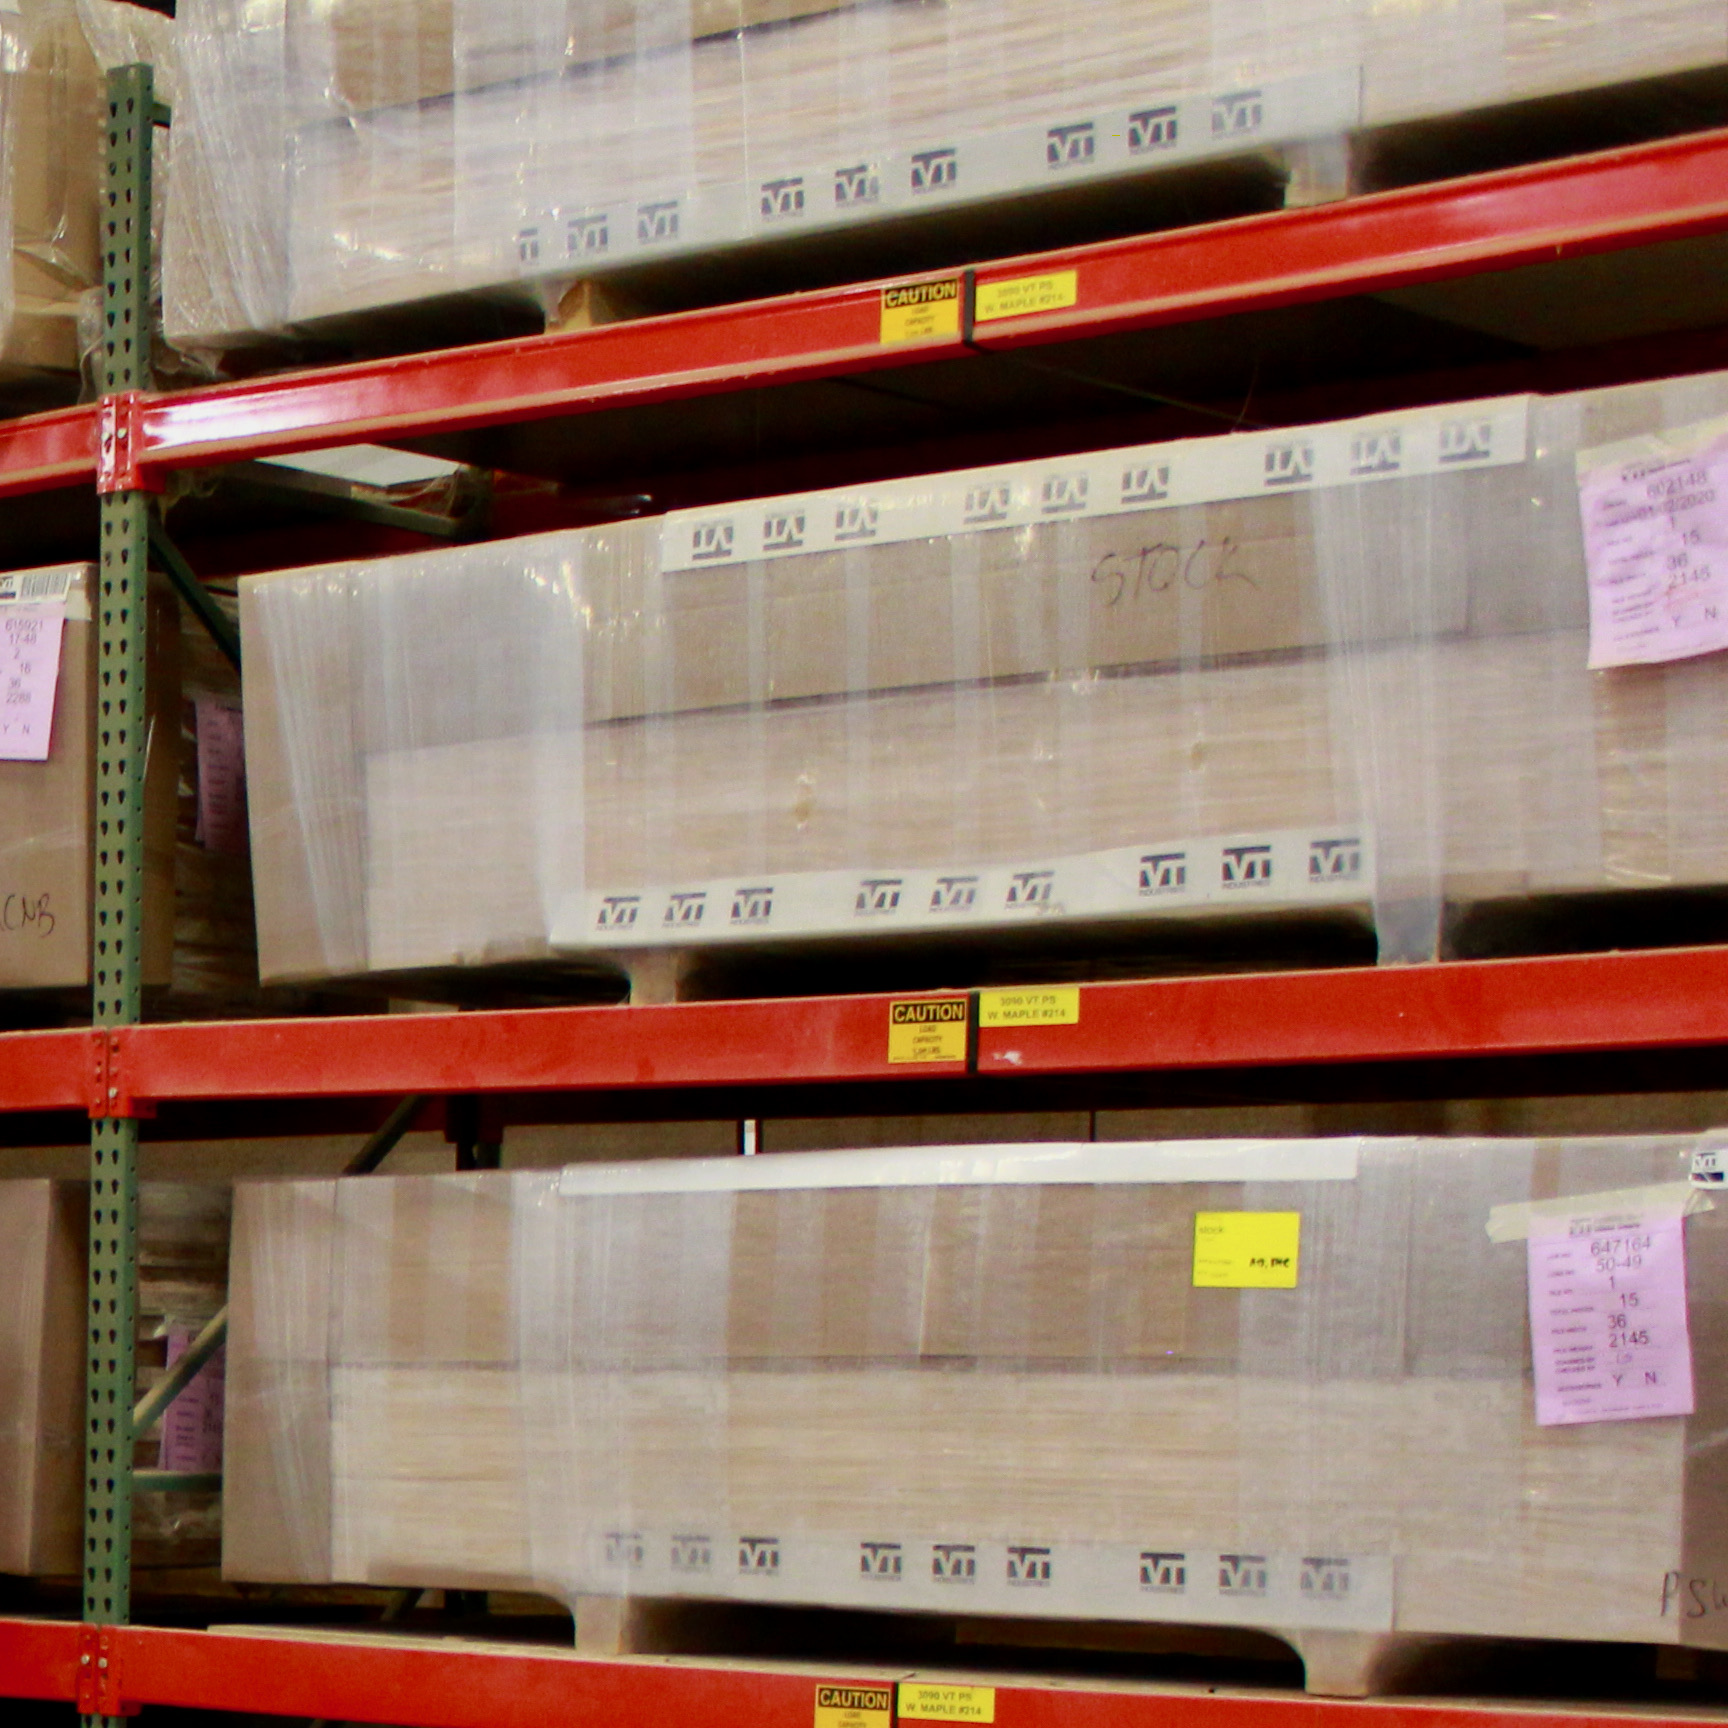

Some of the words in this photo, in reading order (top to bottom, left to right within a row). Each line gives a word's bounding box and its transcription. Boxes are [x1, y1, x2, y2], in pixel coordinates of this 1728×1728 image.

[886, 281, 957, 308] CAUTION
[894, 1001, 964, 1023] CAUTION
[1590, 1236, 1651, 1257] 647164
[1596, 1254, 1642, 1273] 50-49
[1608, 1275, 1616, 1290] 1
[1619, 1291, 1639, 1309] 15
[1607, 1313, 1627, 1330] 36
[1608, 1330, 1649, 1349] 2145
[1612, 1374, 1623, 1387] Y
[1644, 1370, 1657, 1385] N
[819, 1689, 888, 1710] CAUTION
[920, 1704, 955, 1715] MAPLE
